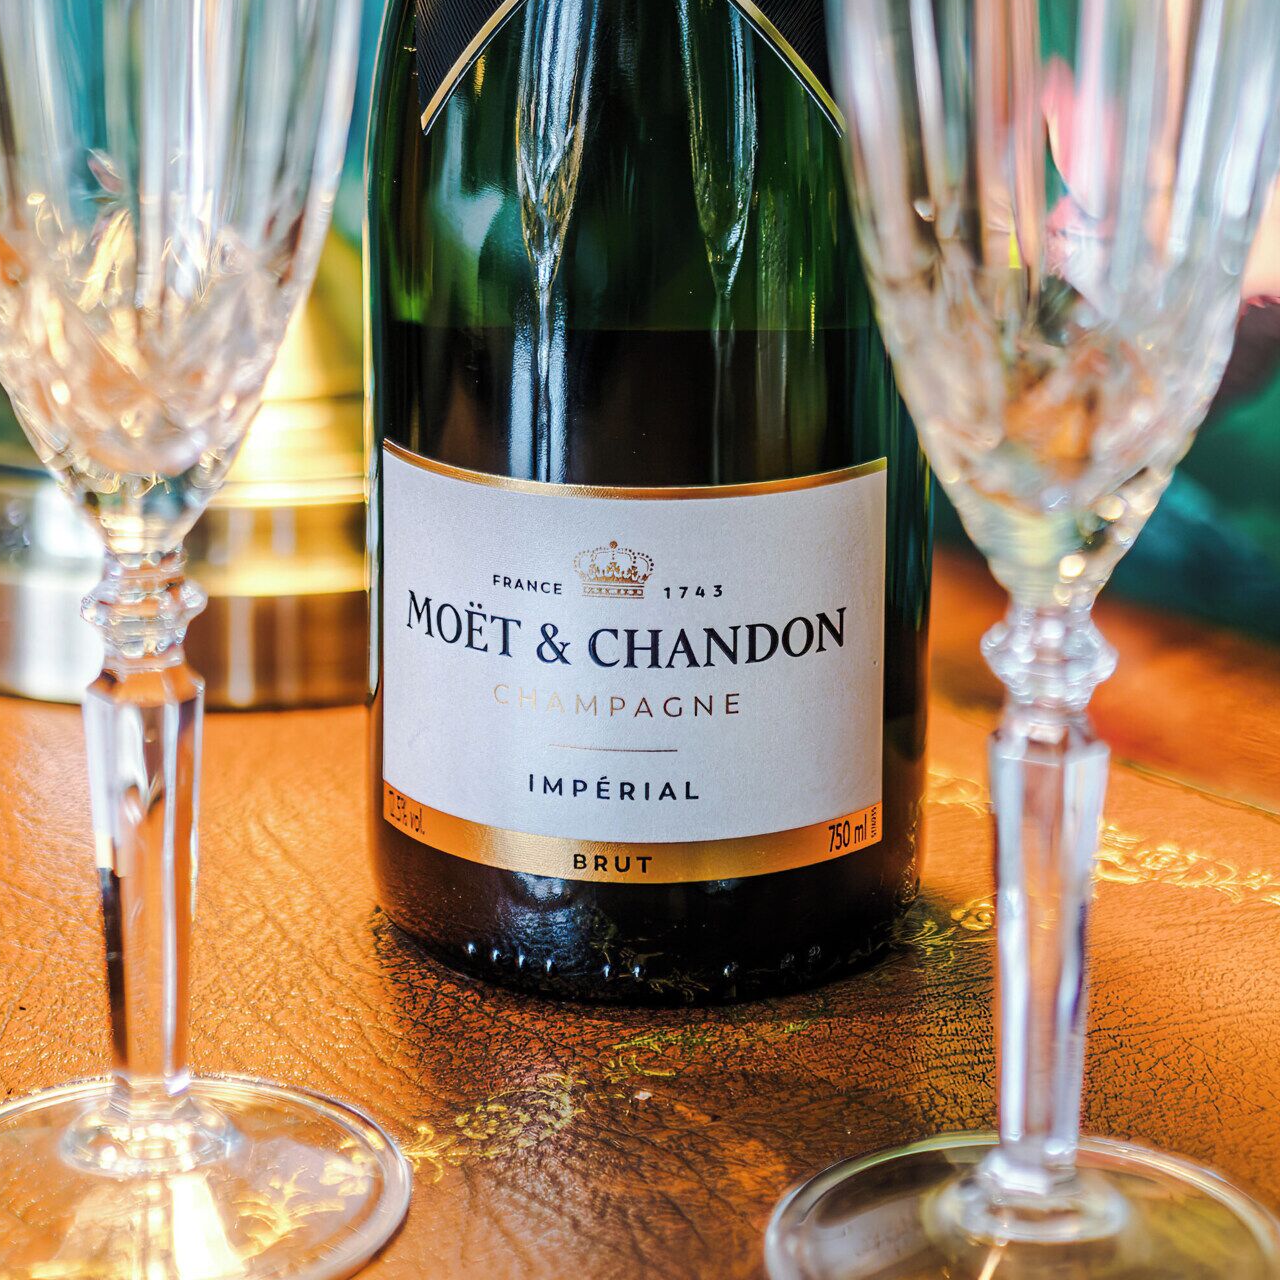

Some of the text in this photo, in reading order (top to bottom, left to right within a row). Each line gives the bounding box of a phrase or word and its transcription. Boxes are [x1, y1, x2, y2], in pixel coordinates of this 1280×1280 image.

[493, 575, 723, 600] FRANCE 1743
[406, 590, 848, 669] MOËT & CHANDON
[493, 683, 741, 718] CHAMPAGNE
[528, 774, 700, 801] IMPÉRIAL
[828, 820, 851, 852] 750
[854, 813, 867, 844] ml
[572, 853, 654, 874] BRUT
